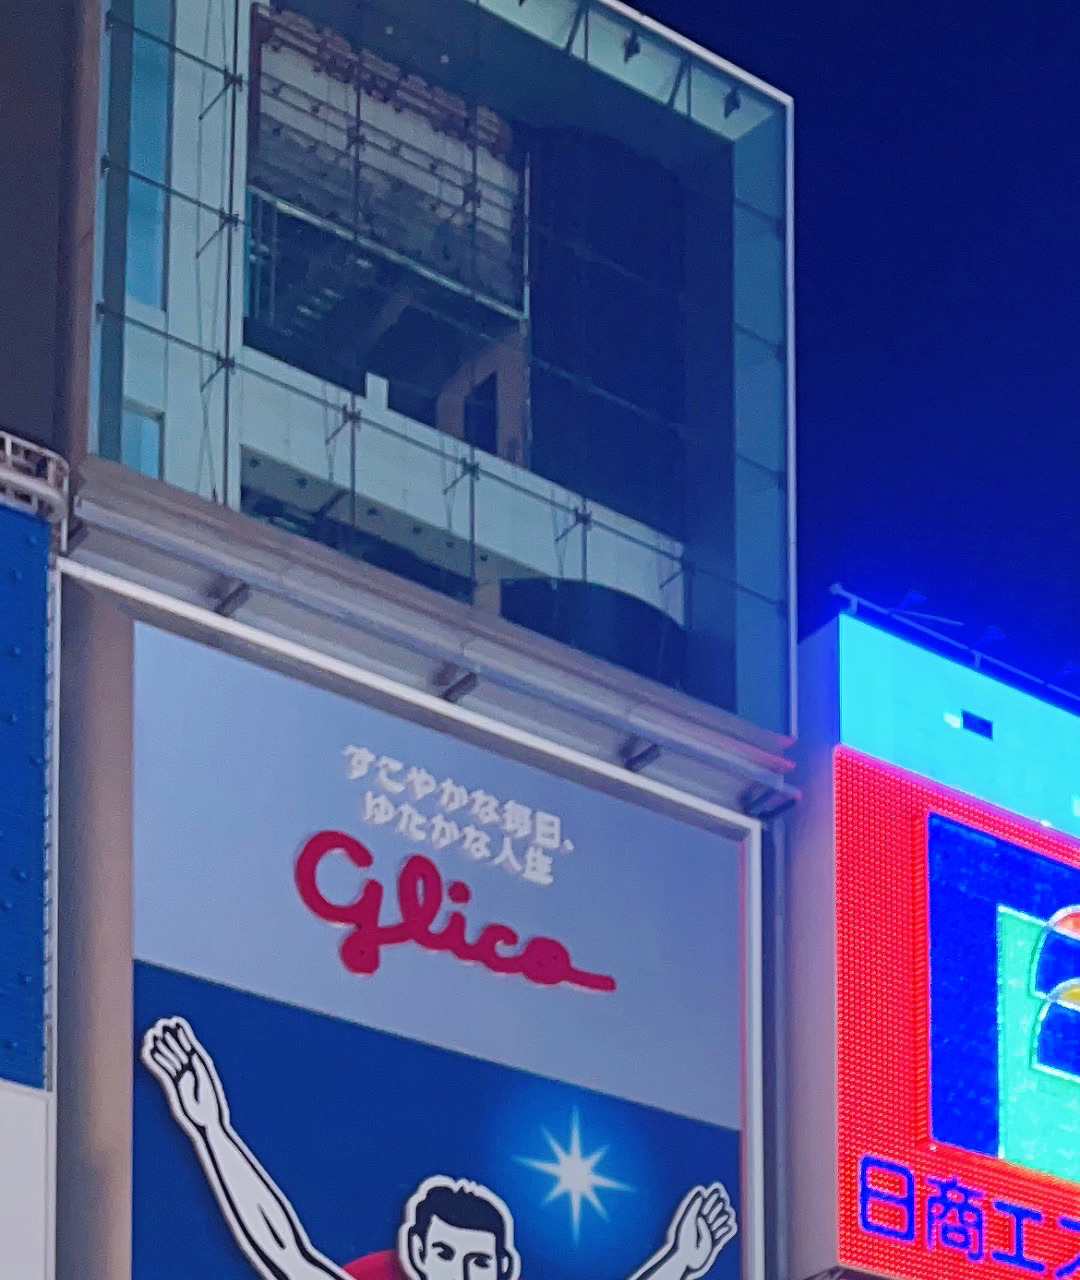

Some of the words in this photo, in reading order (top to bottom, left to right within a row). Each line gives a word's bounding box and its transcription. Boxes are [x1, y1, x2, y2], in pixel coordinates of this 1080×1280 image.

[342, 744, 574, 852] すこやかな毎日、
[363, 791, 554, 886] ゆたかな人生
[295, 829, 617, 992] Glico
